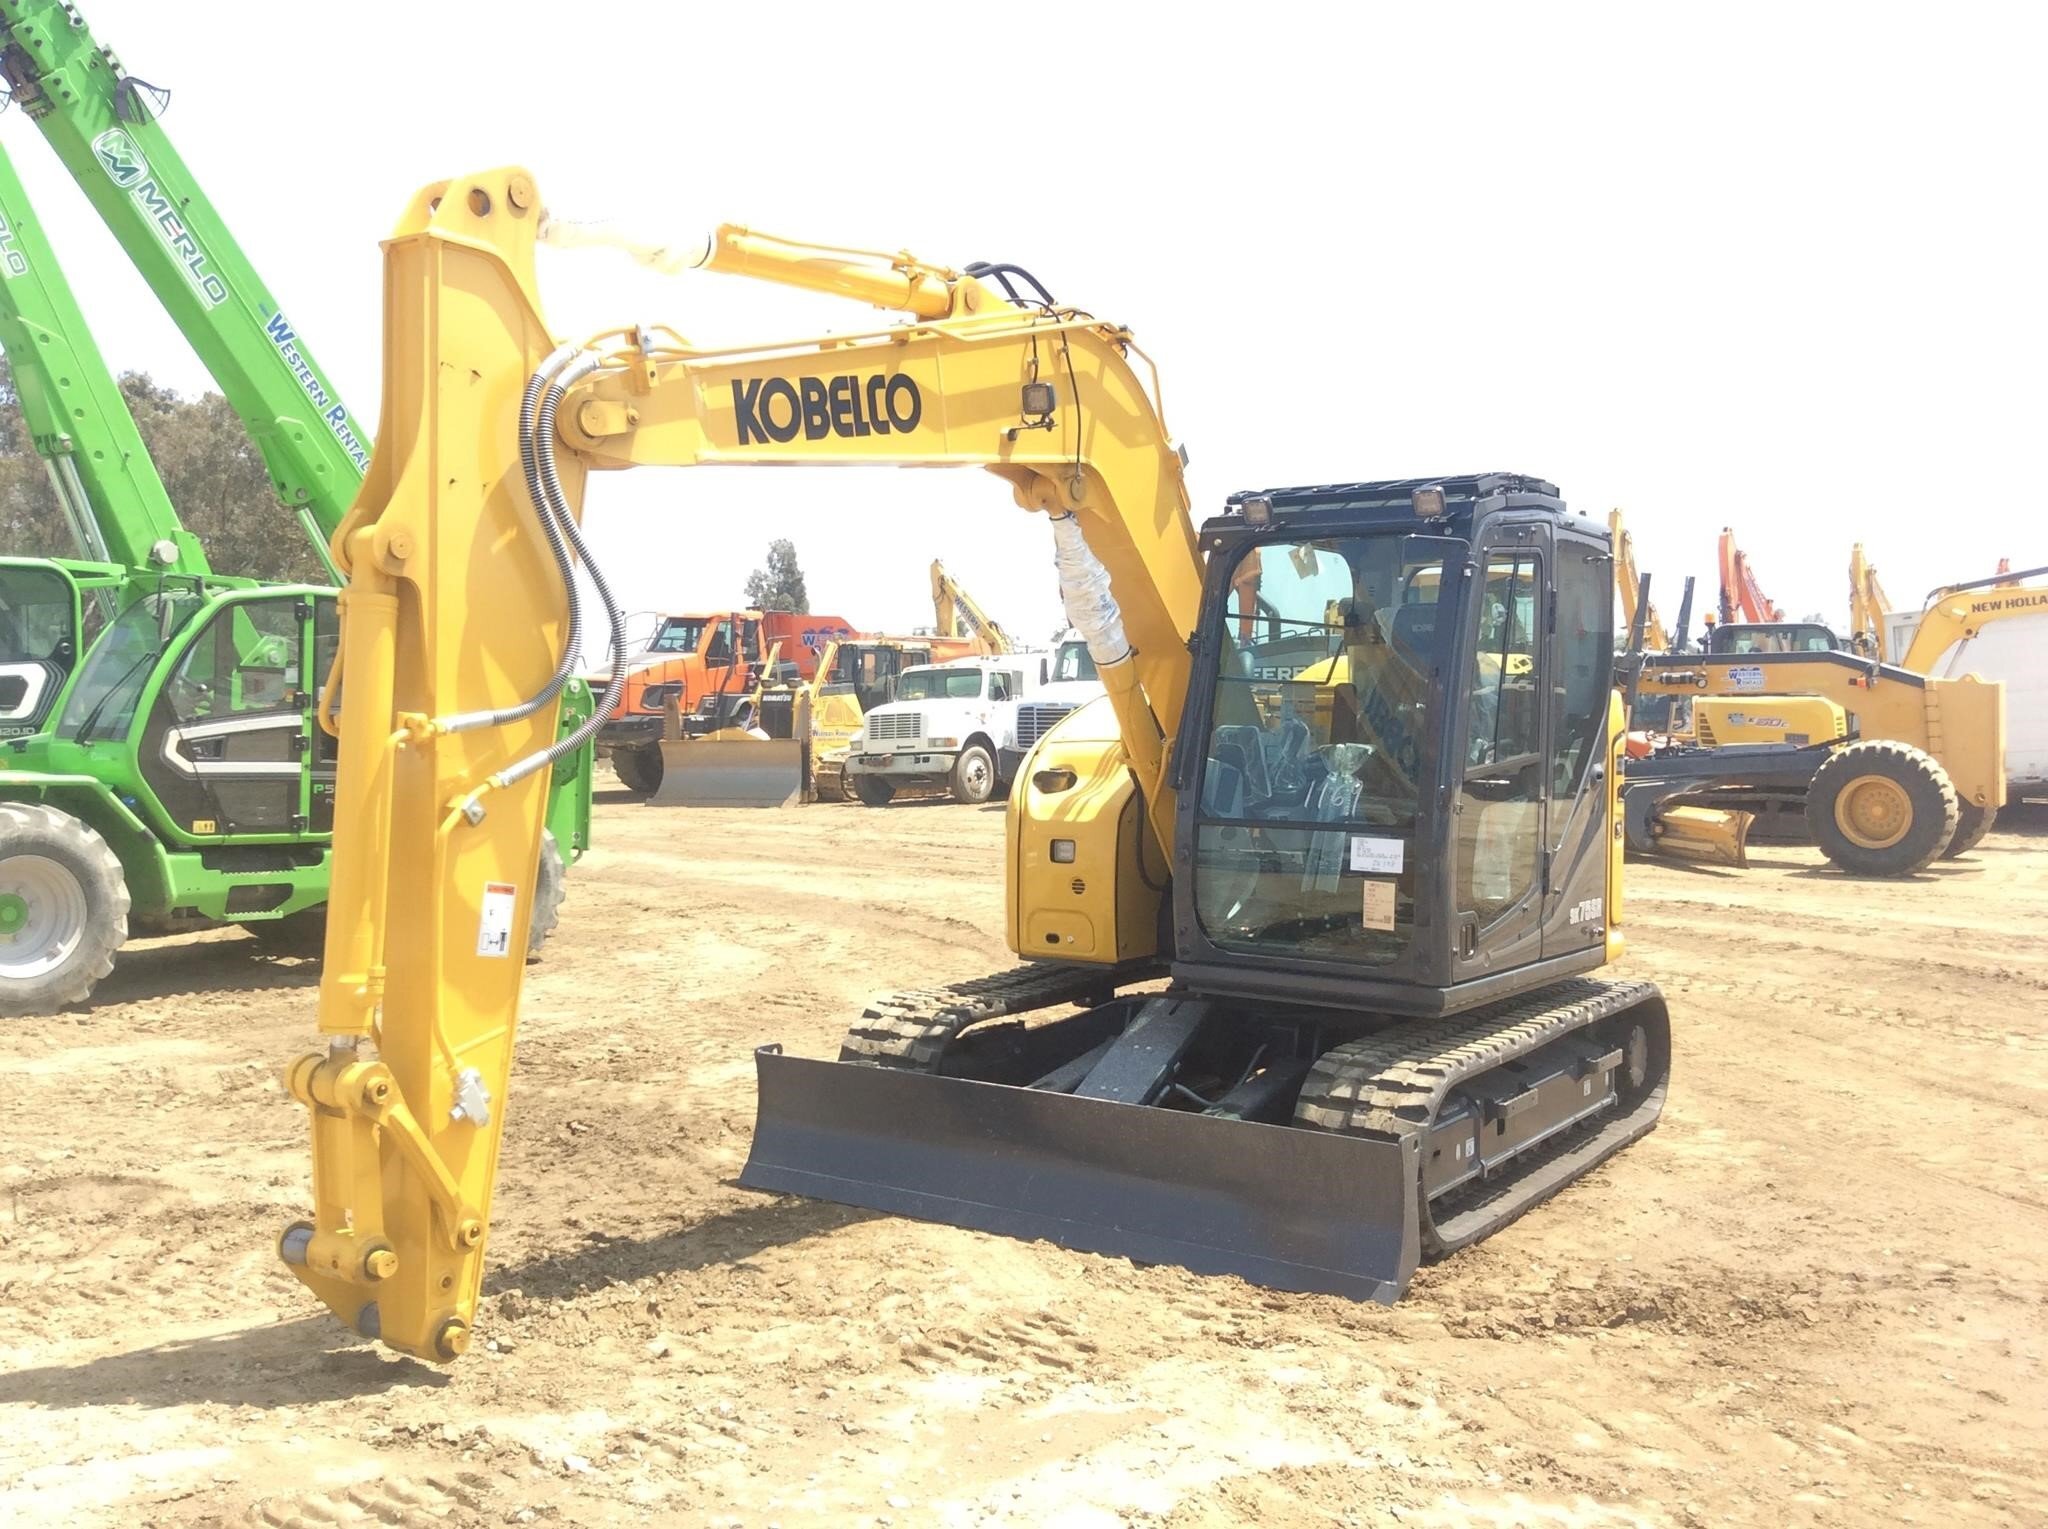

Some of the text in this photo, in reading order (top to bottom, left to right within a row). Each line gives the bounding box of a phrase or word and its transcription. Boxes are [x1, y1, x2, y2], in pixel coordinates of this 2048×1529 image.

[137, 181, 227, 303] MERLO
[266, 312, 329, 408] WESTERN
[731, 373, 922, 446] KOBELCO
[1971, 600, 2002, 613] NEW
